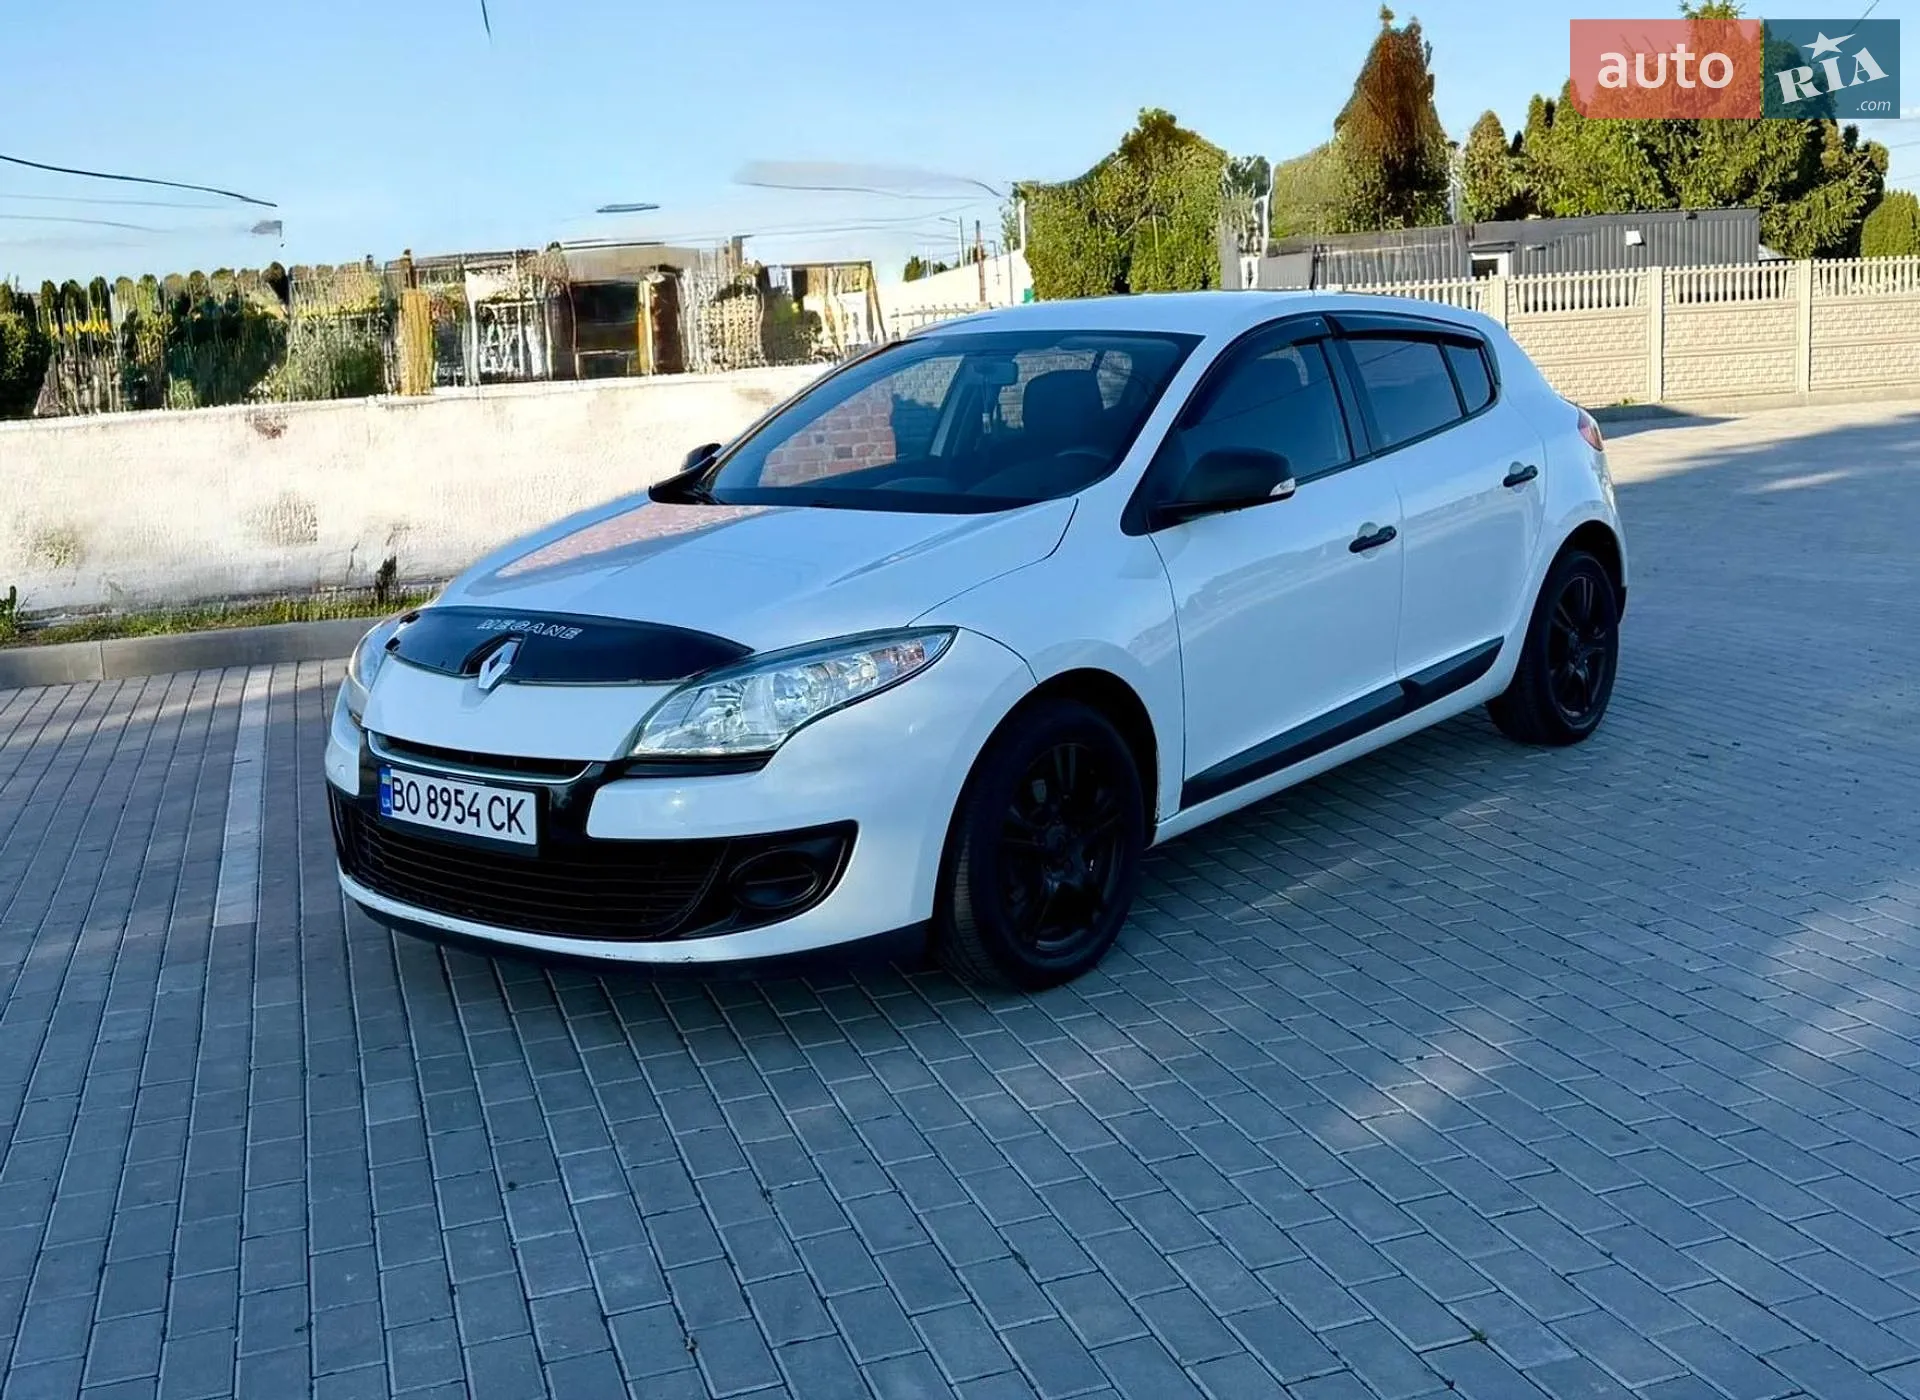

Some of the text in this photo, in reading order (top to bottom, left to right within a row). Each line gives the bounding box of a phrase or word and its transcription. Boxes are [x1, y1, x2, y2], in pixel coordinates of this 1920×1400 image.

[392, 776, 526, 835] BO 8954 CK
